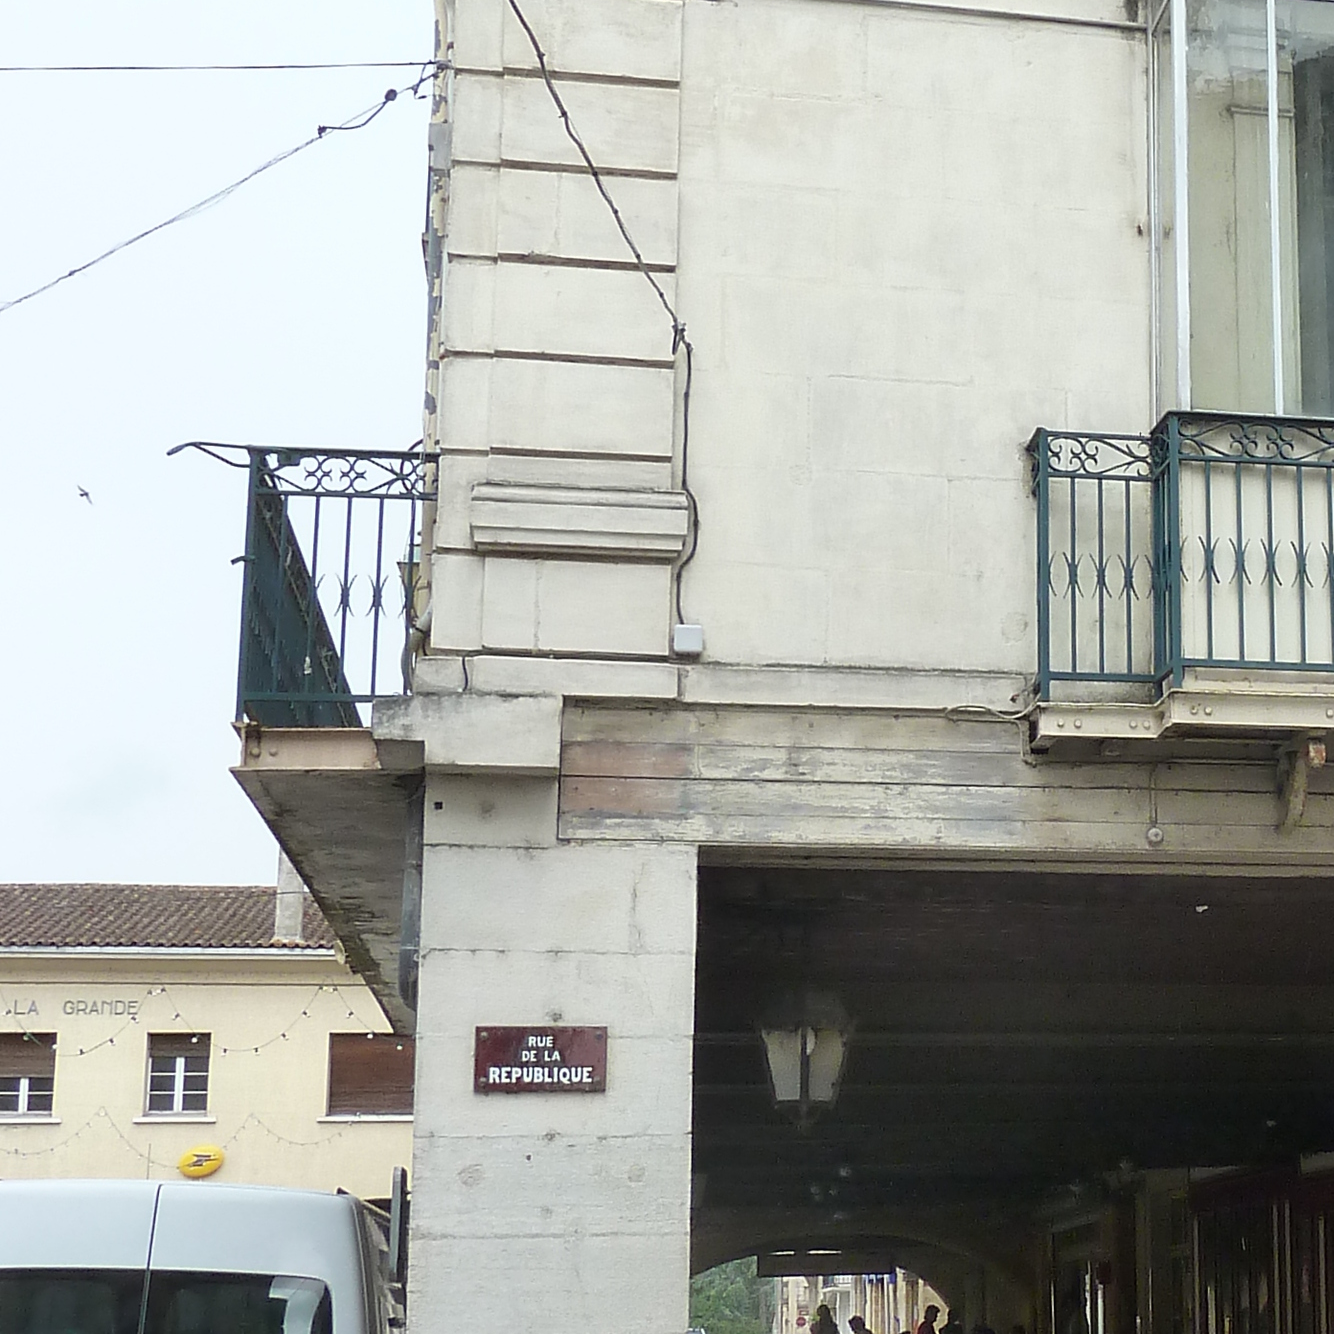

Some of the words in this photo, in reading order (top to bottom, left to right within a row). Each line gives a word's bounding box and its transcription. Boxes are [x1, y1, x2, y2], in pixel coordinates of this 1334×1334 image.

[13, 1000, 39, 1015] LA
[63, 1000, 139, 1015] GRANDE
[528, 1035, 554, 1047] RUE
[521, 1051, 537, 1062] DE
[544, 1050, 561, 1062] LA
[488, 1066, 593, 1084] REPUBLIQUE
